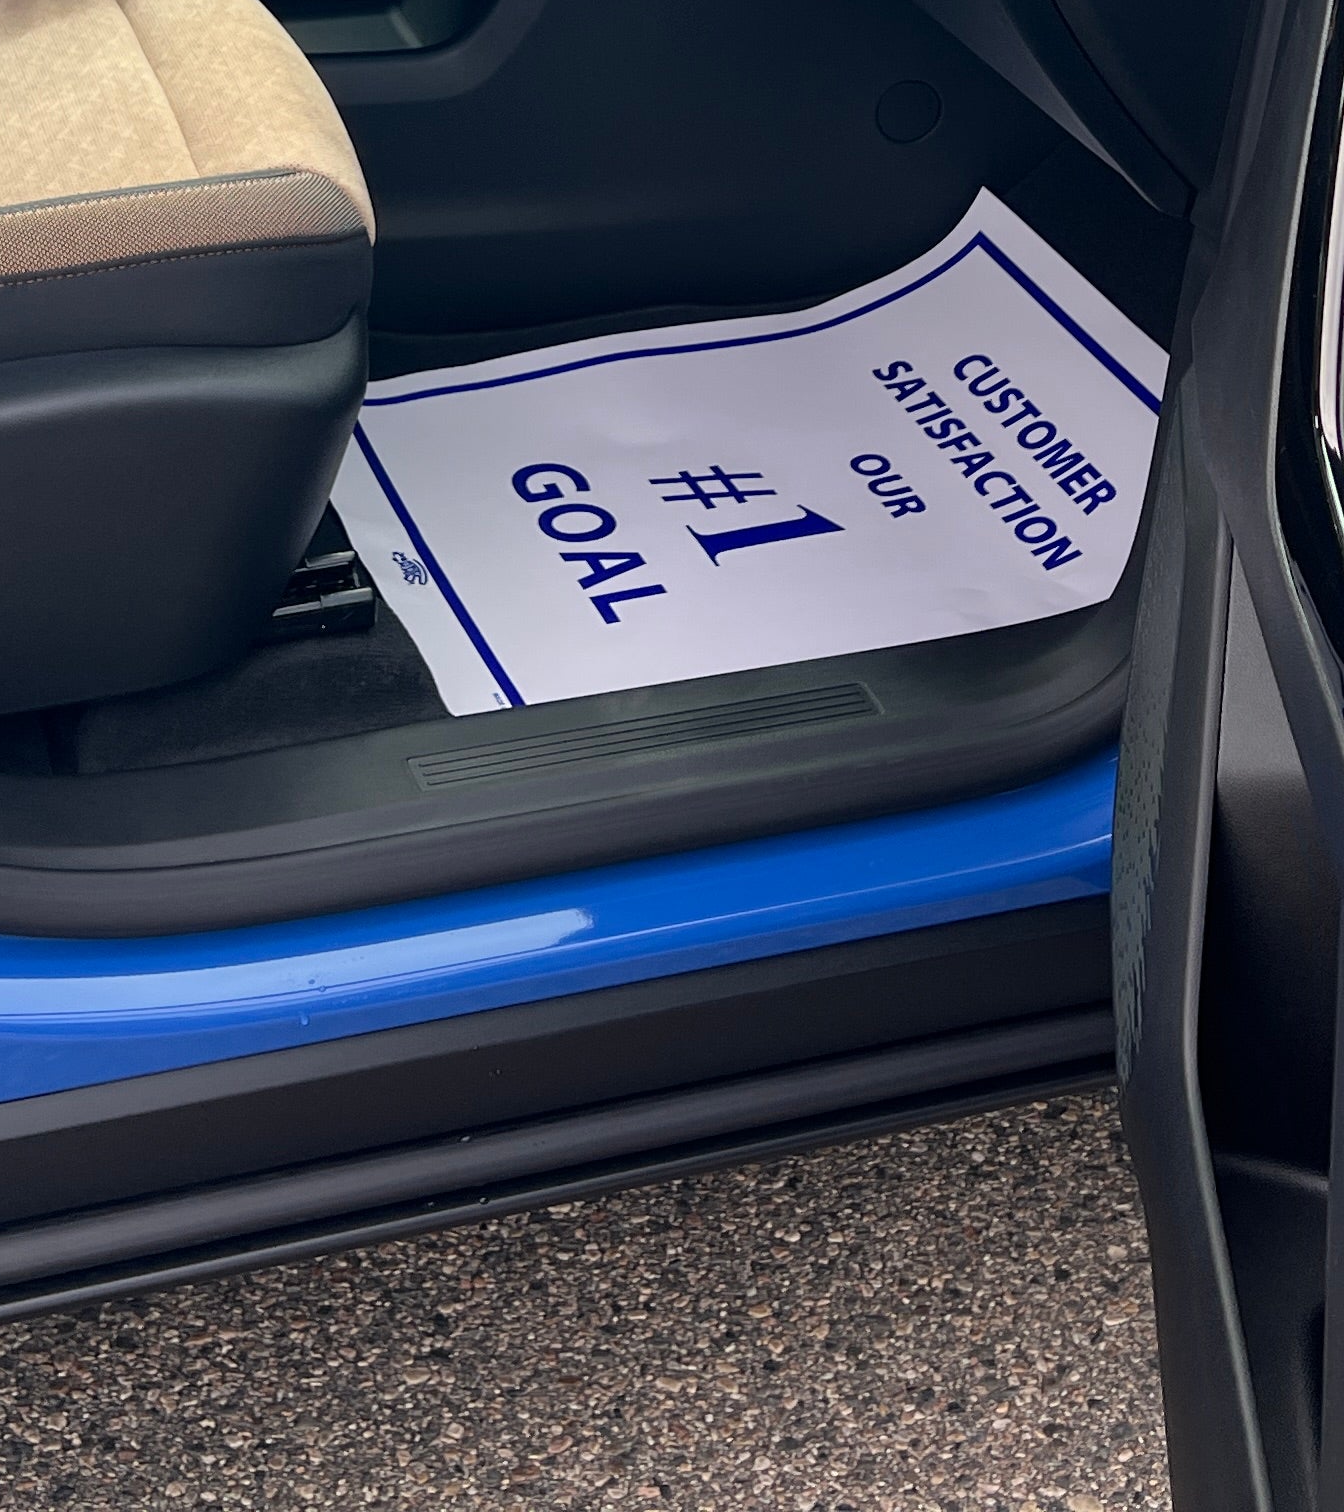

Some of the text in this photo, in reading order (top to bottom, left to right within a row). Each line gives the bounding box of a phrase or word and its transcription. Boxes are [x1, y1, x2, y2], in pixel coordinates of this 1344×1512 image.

[649, 464, 844, 567] #1
[850, 453, 927, 519] OUR
[873, 360, 1082, 571] SATISFACTION
[953, 354, 1117, 516] CUSTOMER
[511, 463, 667, 625] GOAL
